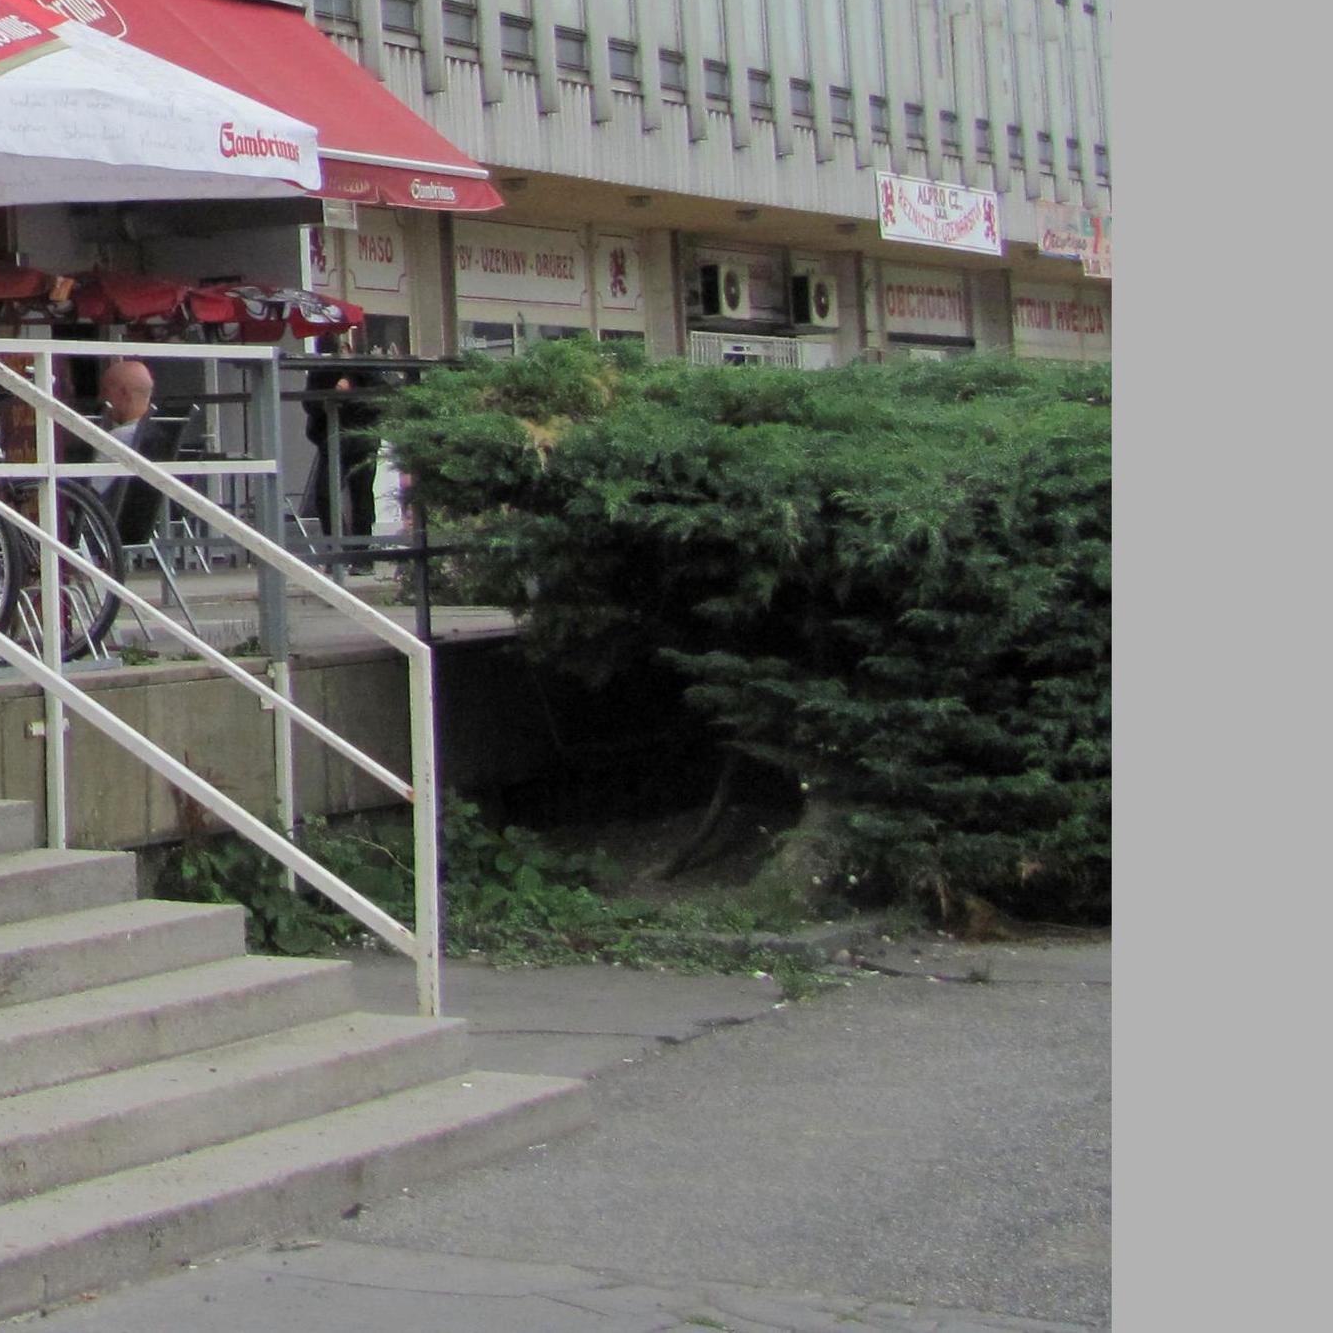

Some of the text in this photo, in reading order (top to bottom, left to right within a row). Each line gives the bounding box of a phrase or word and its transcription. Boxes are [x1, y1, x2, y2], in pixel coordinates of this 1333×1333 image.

[219, 121, 301, 162] Gambrinus
[410, 178, 456, 201] Gambrinus
[358, 234, 394, 263] MASO
